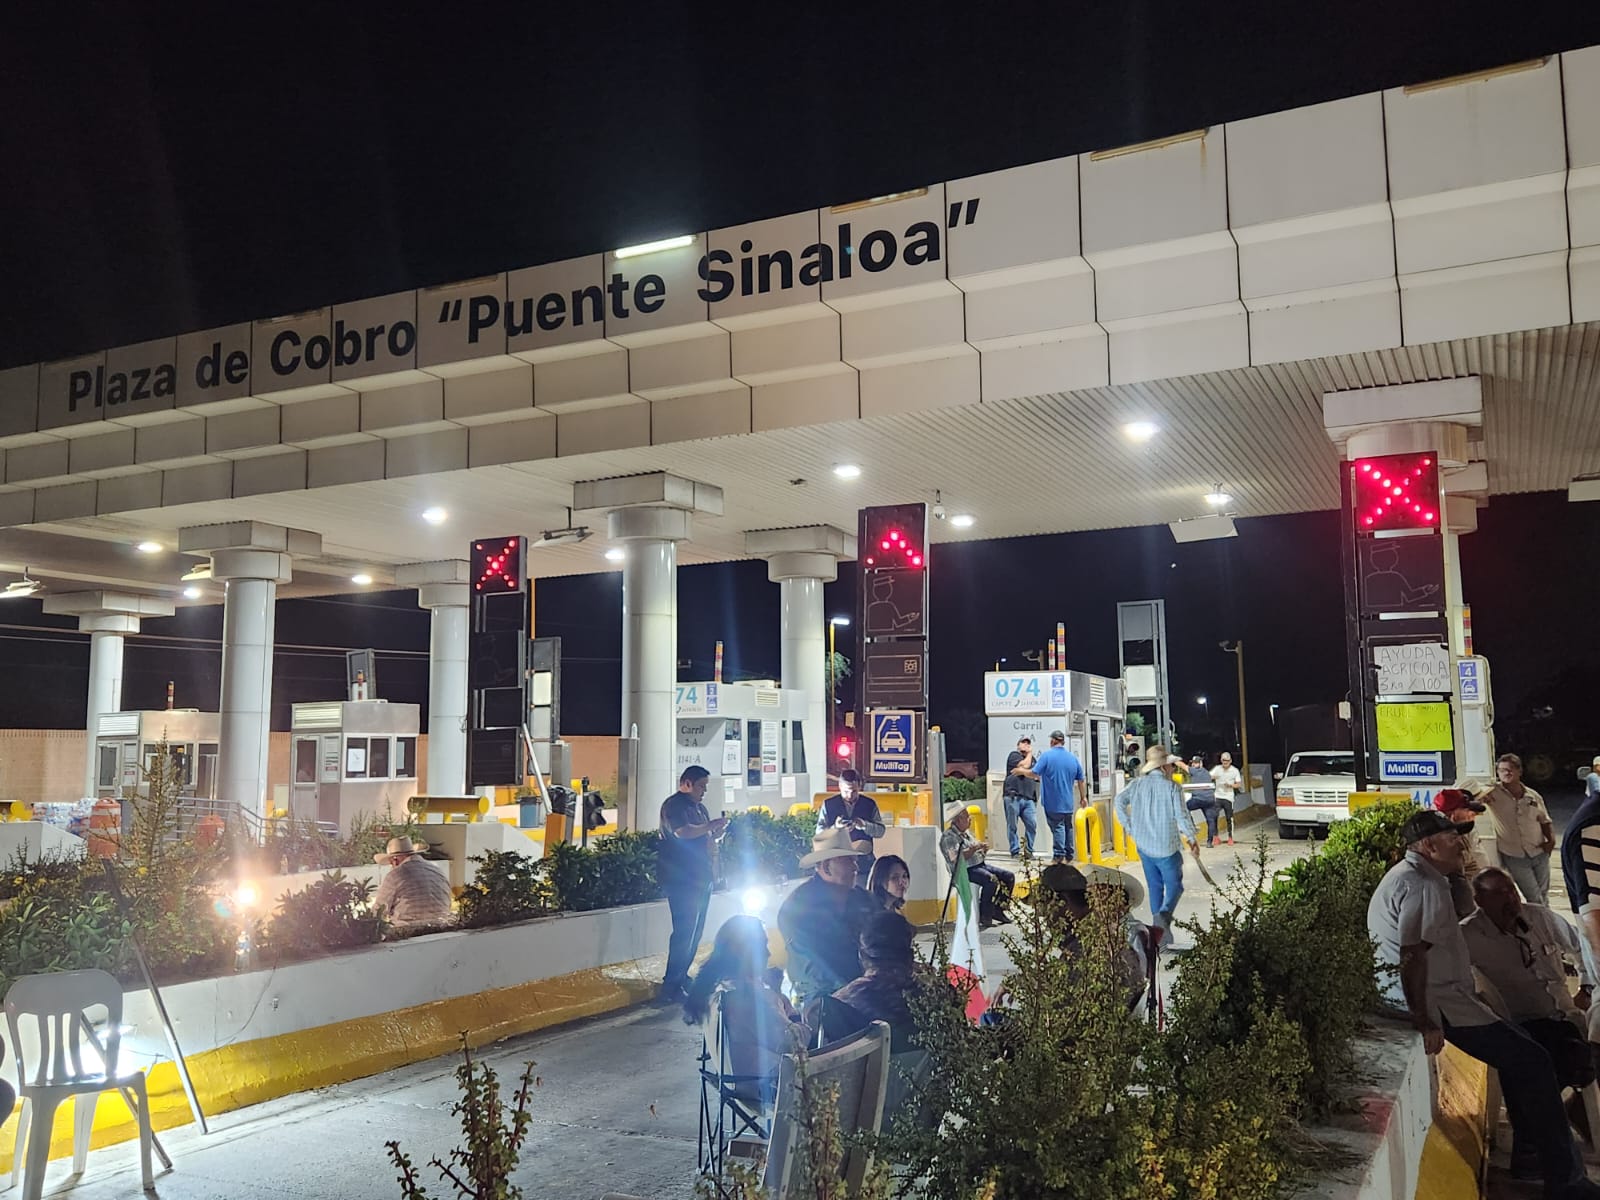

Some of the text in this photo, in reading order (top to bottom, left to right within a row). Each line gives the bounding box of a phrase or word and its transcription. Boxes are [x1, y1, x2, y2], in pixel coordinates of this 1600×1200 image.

[68, 364, 176, 412] Plaza
[195, 342, 249, 389] de
[269, 319, 417, 376] Cobro
[1381, 646, 1436, 663] AYUDA
[1464, 667, 1472, 677] 4
[996, 679, 1040, 697] 074
[681, 725, 705, 735] Carril
[1013, 721, 1043, 730] Carril
